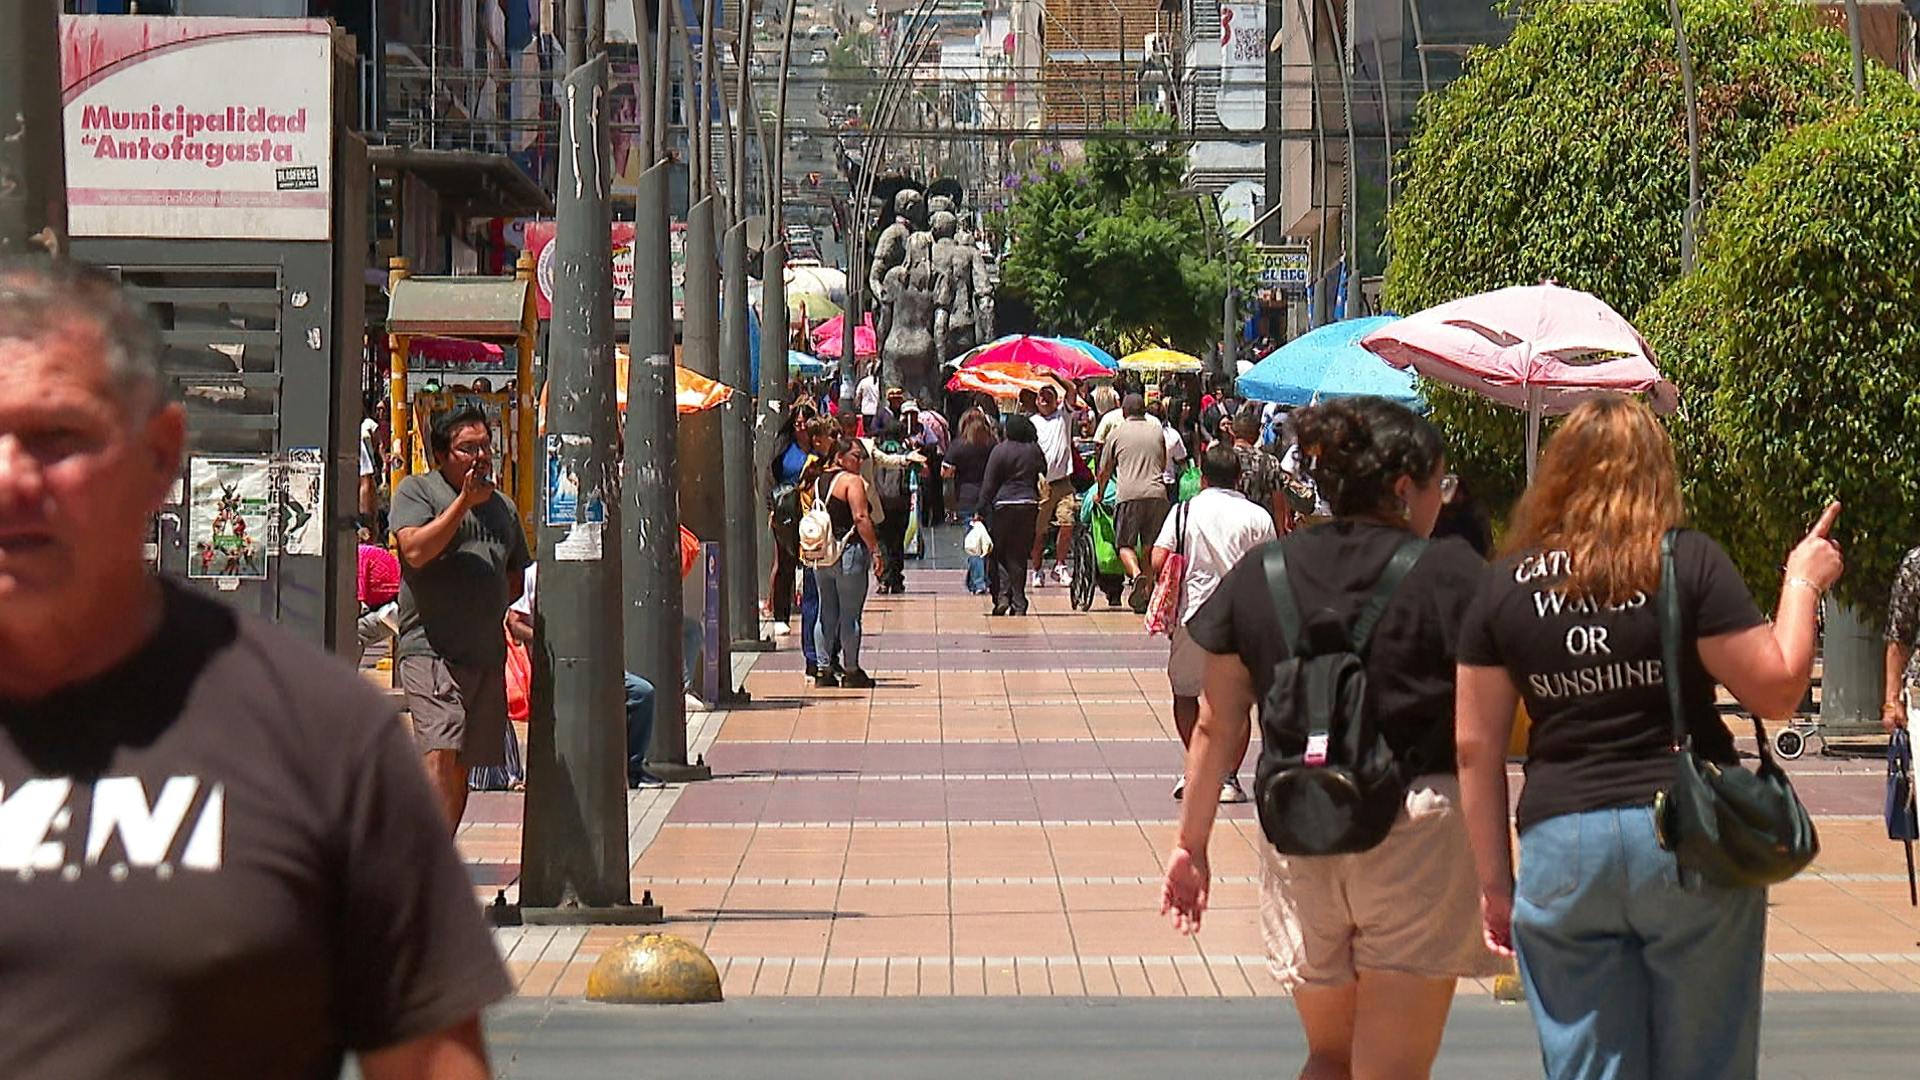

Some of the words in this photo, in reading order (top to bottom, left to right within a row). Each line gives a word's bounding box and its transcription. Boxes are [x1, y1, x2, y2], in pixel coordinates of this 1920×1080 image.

[81, 105, 307, 137] Municipalidad
[81, 133, 97, 146] de
[94, 134, 293, 168] Antofagasta
[1566, 625, 1611, 655] OR
[1528, 659, 1665, 697] SUNSHINE
